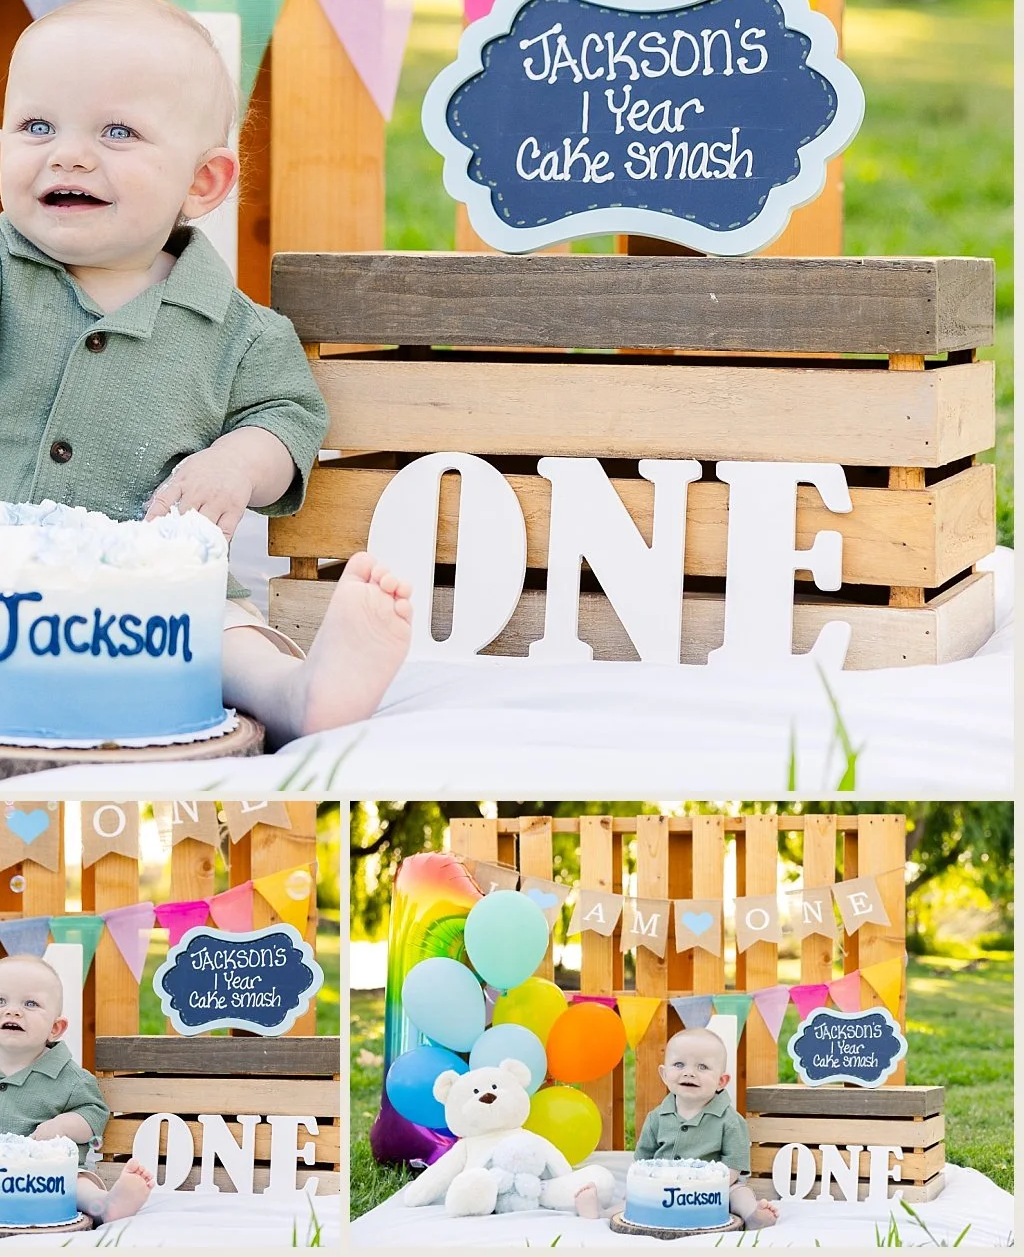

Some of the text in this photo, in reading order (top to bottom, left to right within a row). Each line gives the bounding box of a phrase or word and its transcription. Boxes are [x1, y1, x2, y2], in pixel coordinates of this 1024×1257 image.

[604, 85, 705, 135] Year
[367, 451, 853, 671] ONE
[745, 892, 873, 930] ONE
[223, 971, 262, 990] Year
[837, 1040, 865, 1054] Year
[132, 1112, 320, 1196] ONE
[772, 1142, 905, 1204] ONE
[662, 1187, 722, 1208] Jackson
